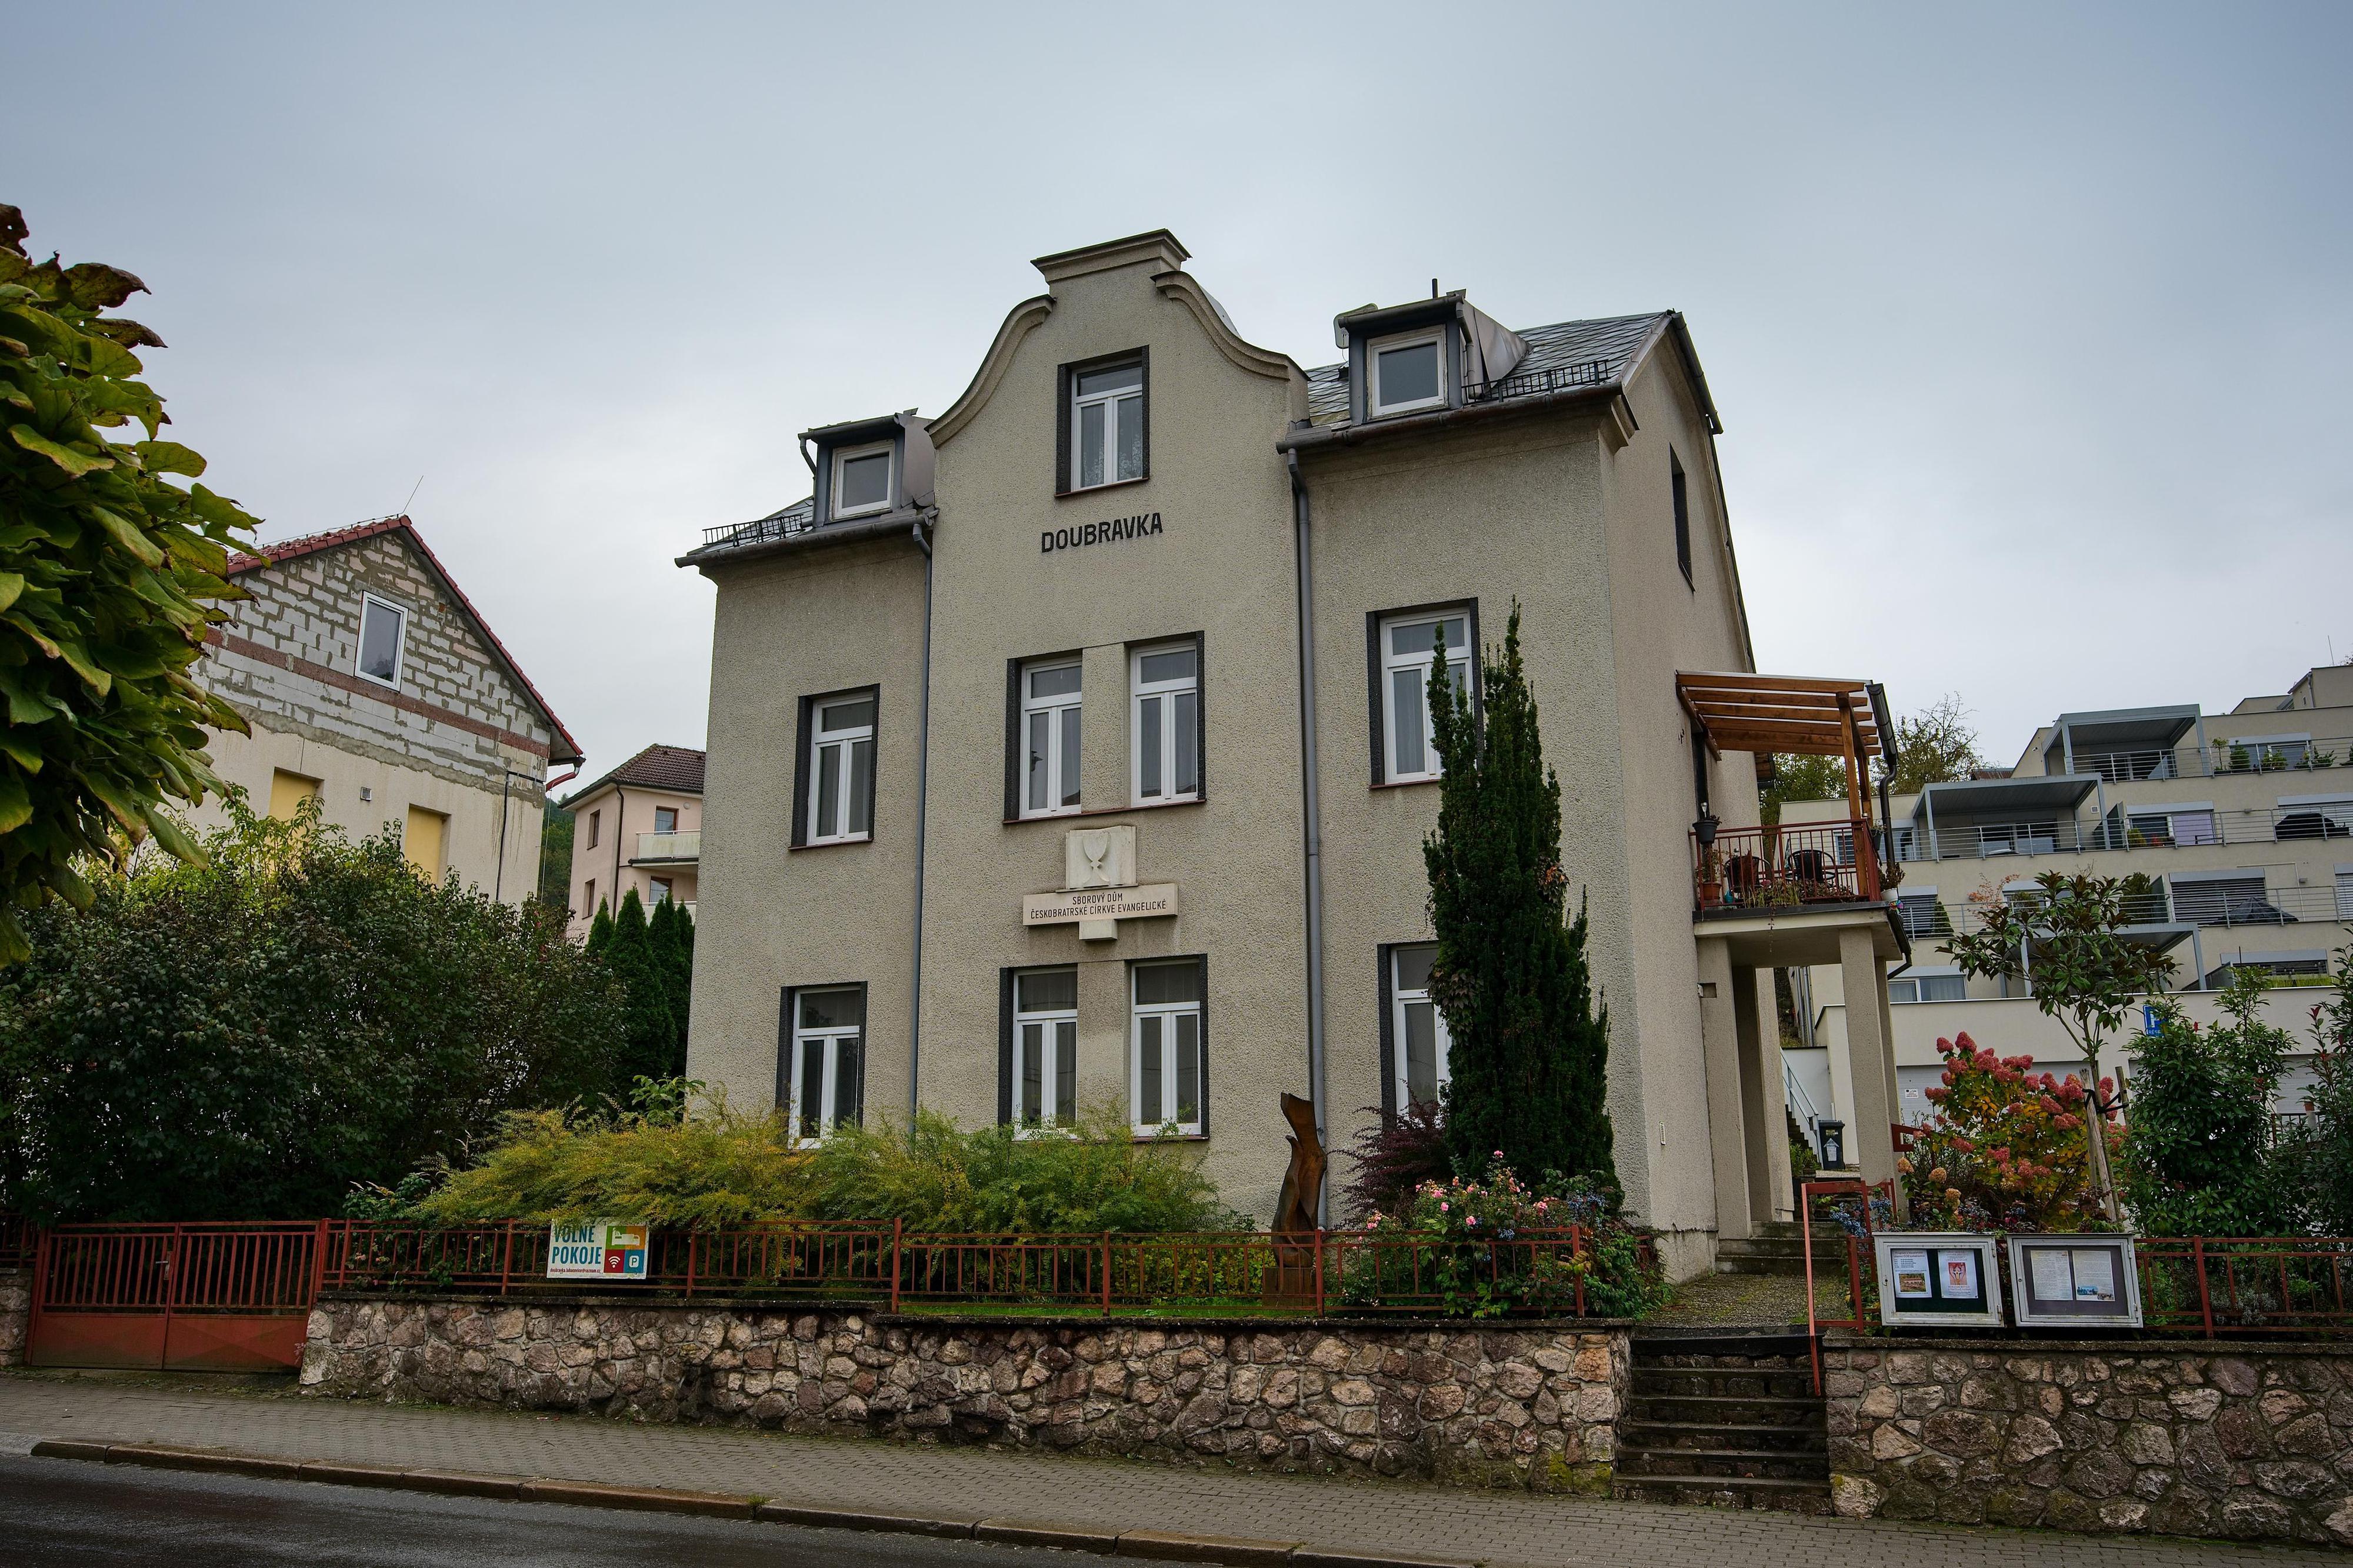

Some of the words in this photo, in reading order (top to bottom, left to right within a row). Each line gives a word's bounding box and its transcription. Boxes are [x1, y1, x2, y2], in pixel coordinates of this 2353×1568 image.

[1042, 512, 1163, 553] DOUBRAVKA
[1072, 893, 1105, 905] SBOROVÝ
[1107, 892, 1123, 902] DŮM
[1031, 905, 1088, 919] ČESKOBRATRSKÉ
[1089, 904, 1115, 915] CÍRKVE
[1118, 899, 1166, 913] EVANGELICKÉ
[552, 1246, 602, 1265] POKOJE
[631, 1257, 638, 1266] P
